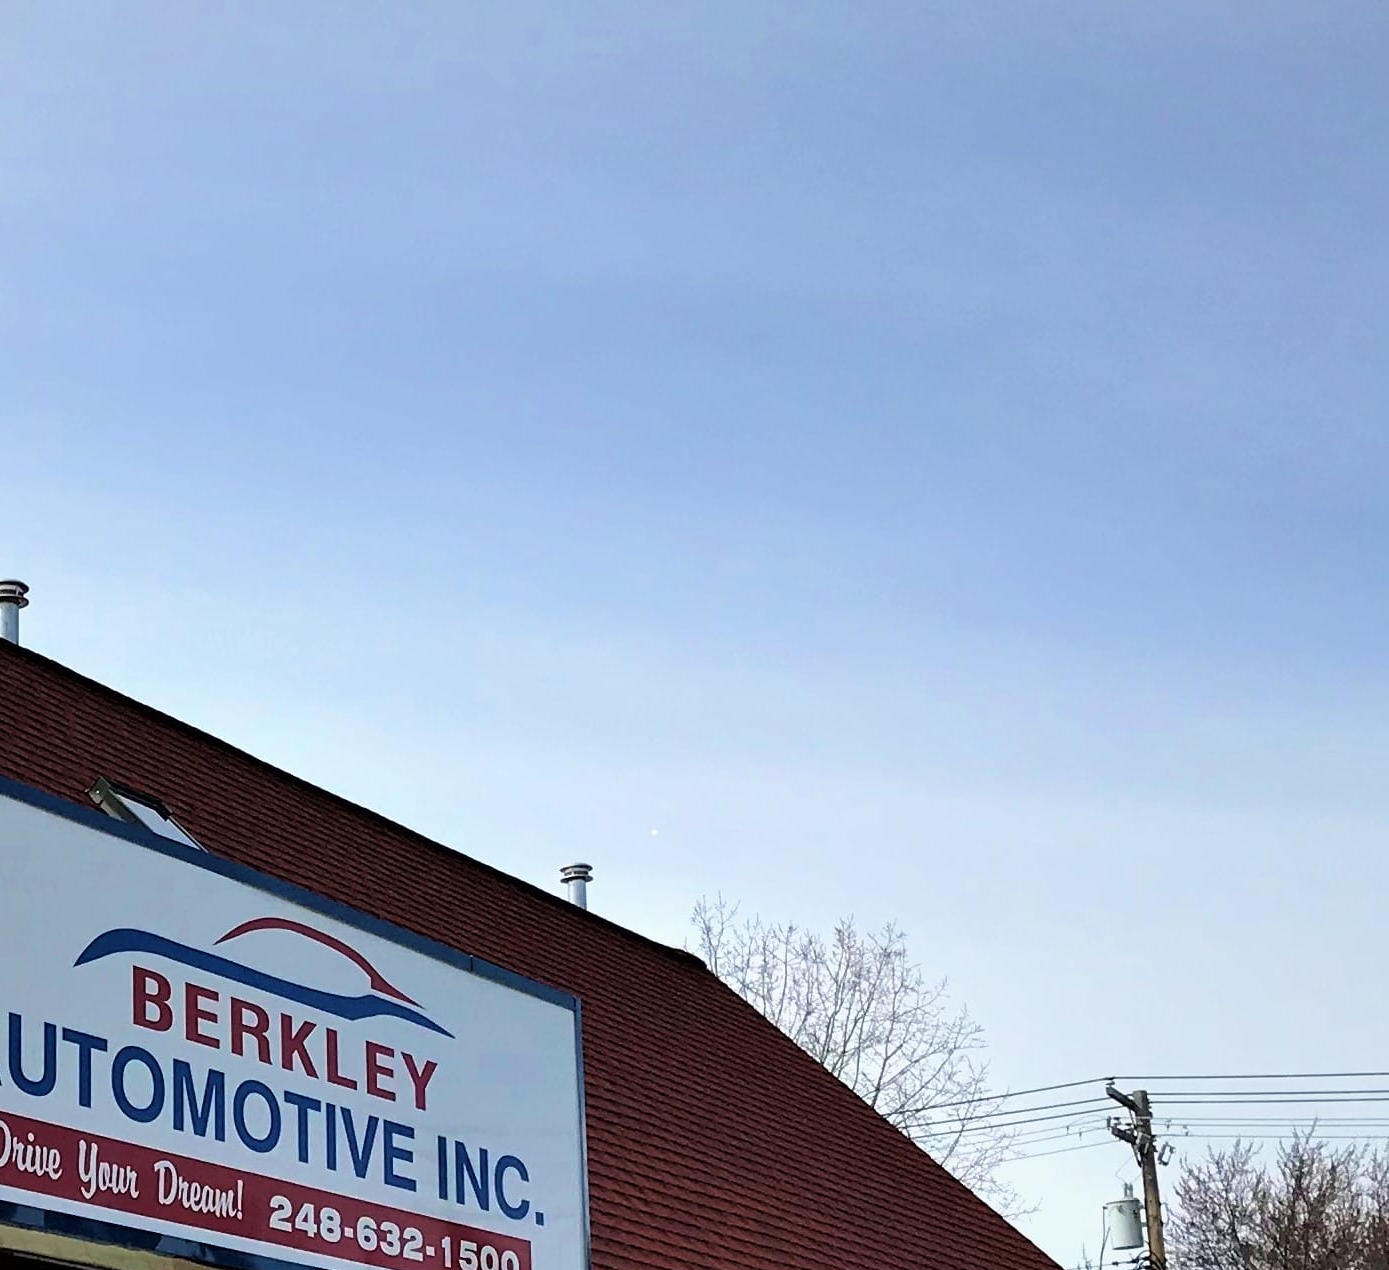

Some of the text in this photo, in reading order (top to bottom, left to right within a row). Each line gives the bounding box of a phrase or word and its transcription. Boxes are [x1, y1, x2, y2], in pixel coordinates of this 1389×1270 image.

[132, 965, 438, 1111] BERKLEY
[78, 1139, 139, 1199] Your
[154, 1160, 244, 1220] Dream!
[437, 1135, 545, 1226] INC.
